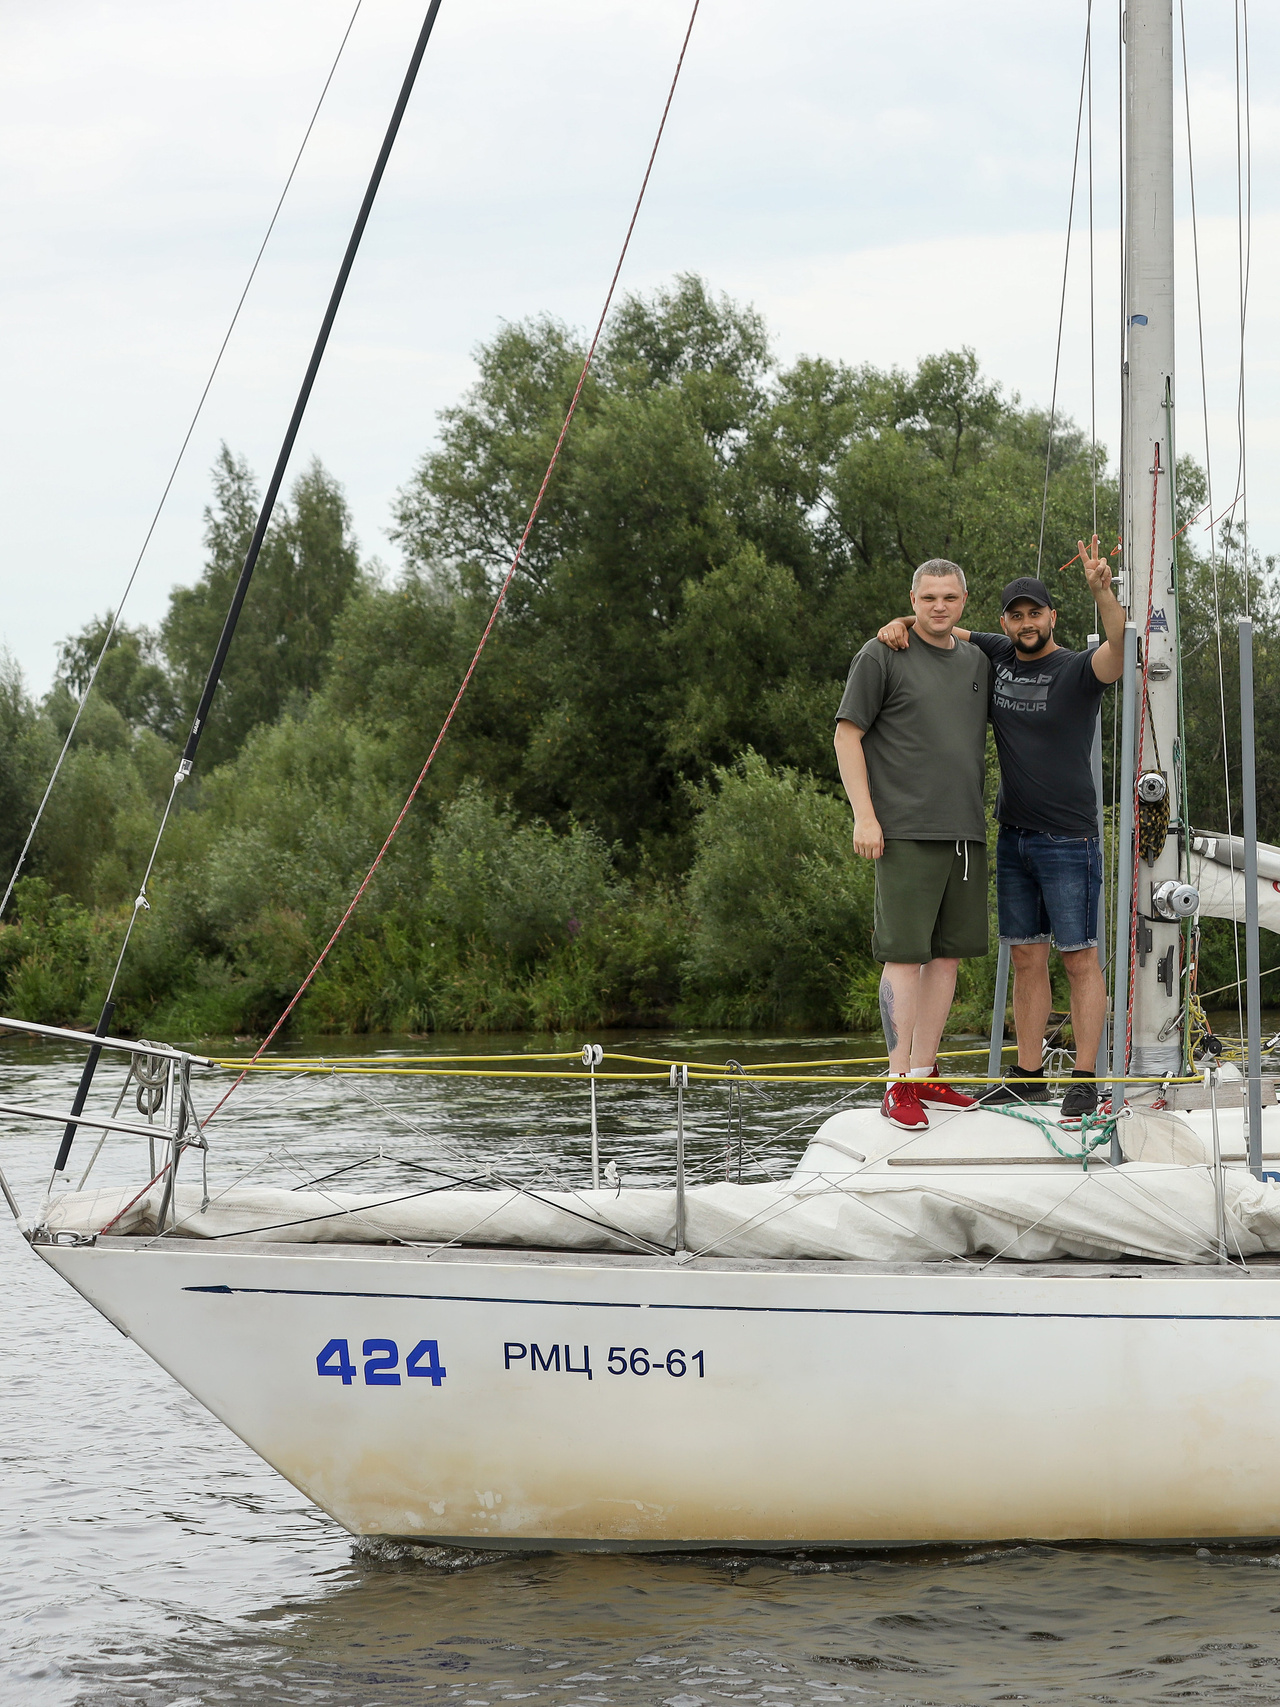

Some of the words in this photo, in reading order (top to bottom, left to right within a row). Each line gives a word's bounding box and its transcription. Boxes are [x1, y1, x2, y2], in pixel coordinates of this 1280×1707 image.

[316, 1338, 447, 1386] 424
[503, 1342, 593, 1380] РМЦ
[607, 1346, 706, 1378] 56-61
